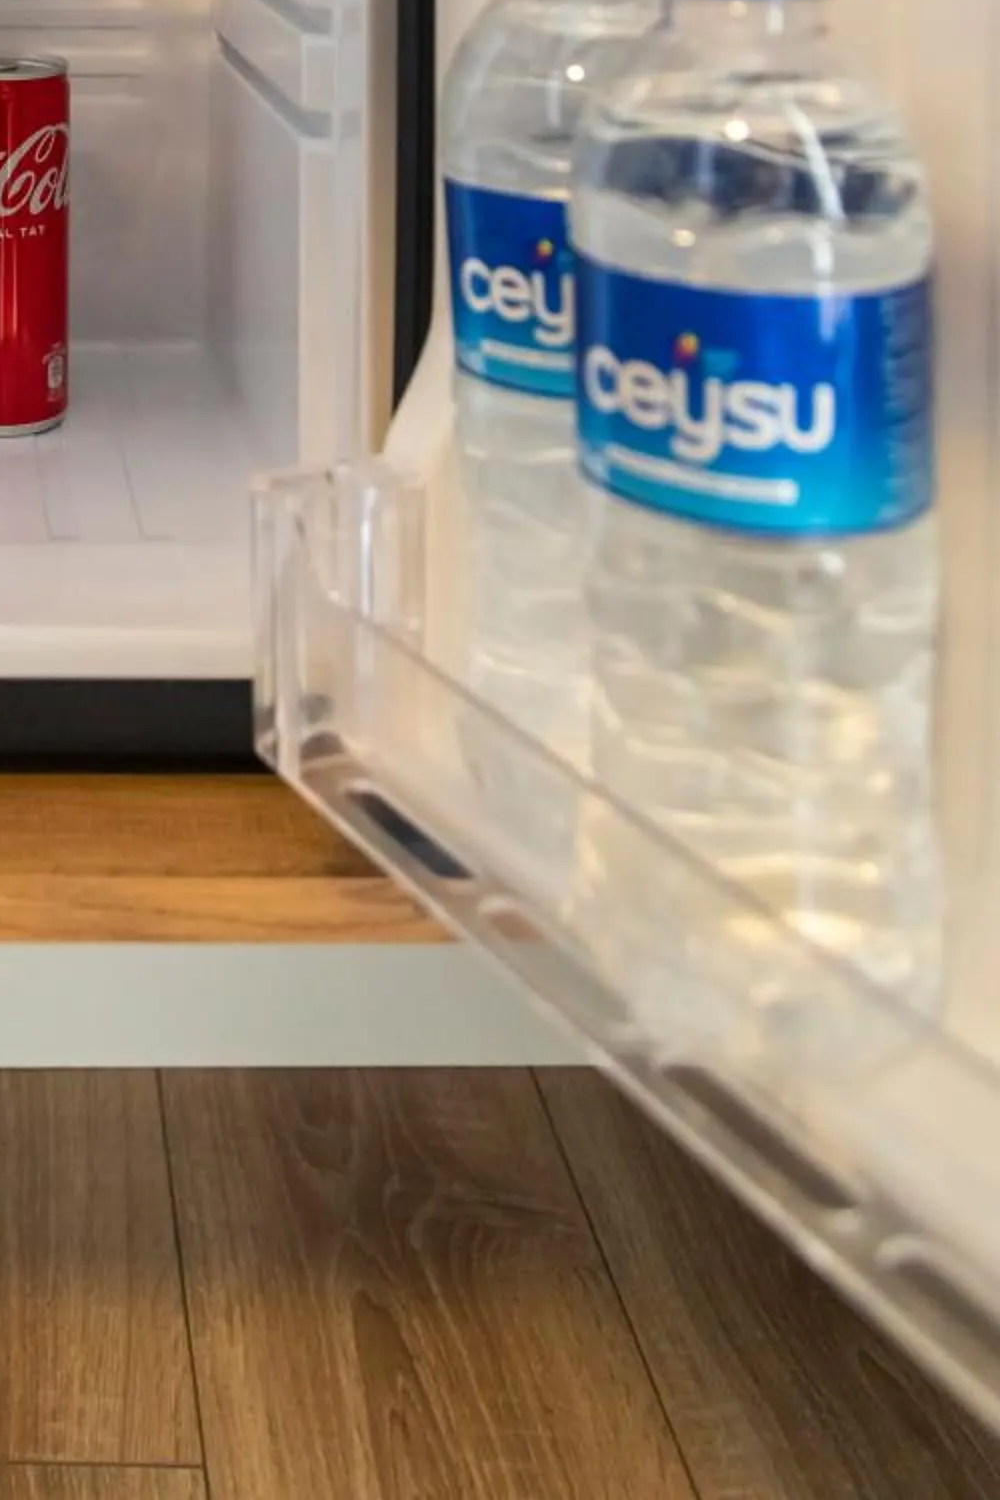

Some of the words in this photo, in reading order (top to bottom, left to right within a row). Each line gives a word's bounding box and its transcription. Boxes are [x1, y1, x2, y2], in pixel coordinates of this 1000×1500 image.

[19, 224, 46, 238] TAT
[460, 257, 575, 346] cey
[584, 344, 835, 463] ceysu
